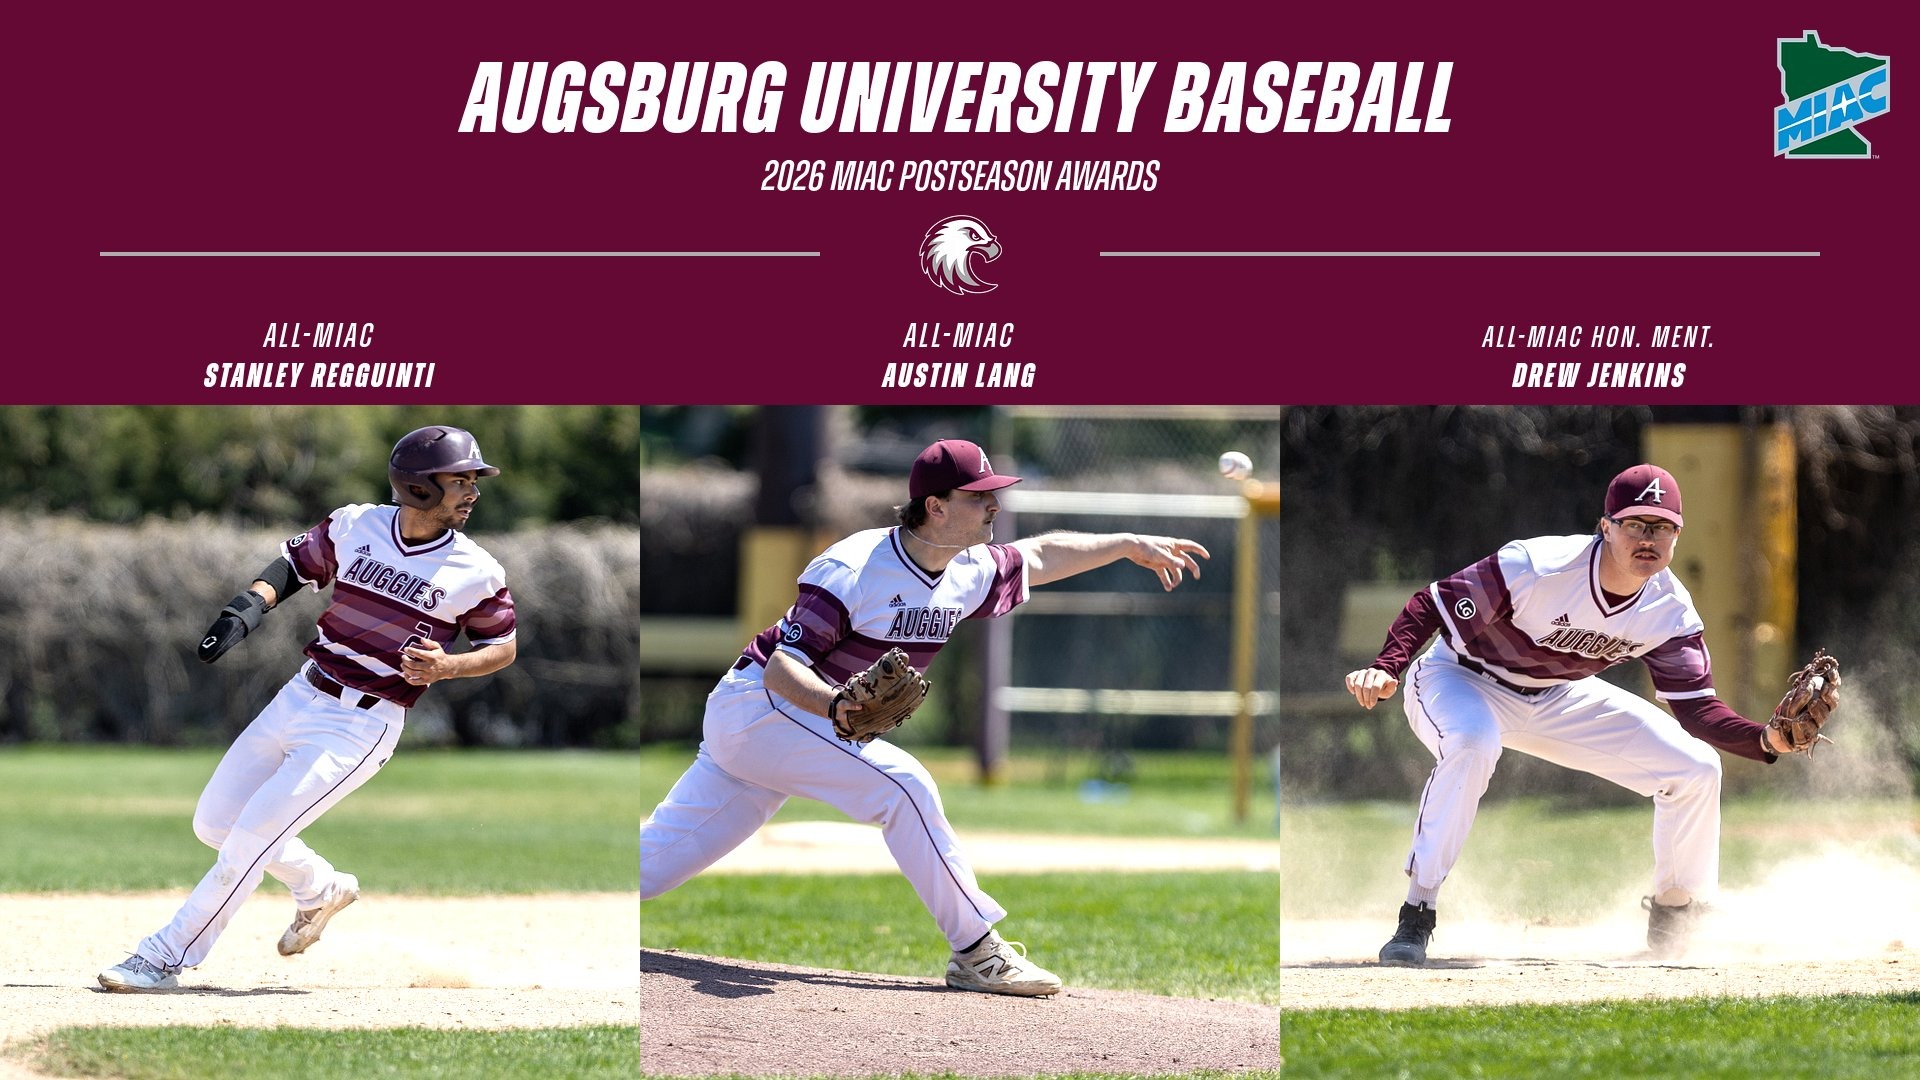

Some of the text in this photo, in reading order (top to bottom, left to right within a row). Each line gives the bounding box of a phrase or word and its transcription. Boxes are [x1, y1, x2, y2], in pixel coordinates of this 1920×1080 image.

[978, 446, 993, 473] A
[1634, 477, 1667, 503] A
[341, 556, 447, 612] AUGGIES
[1459, 600, 1473, 617] LG
